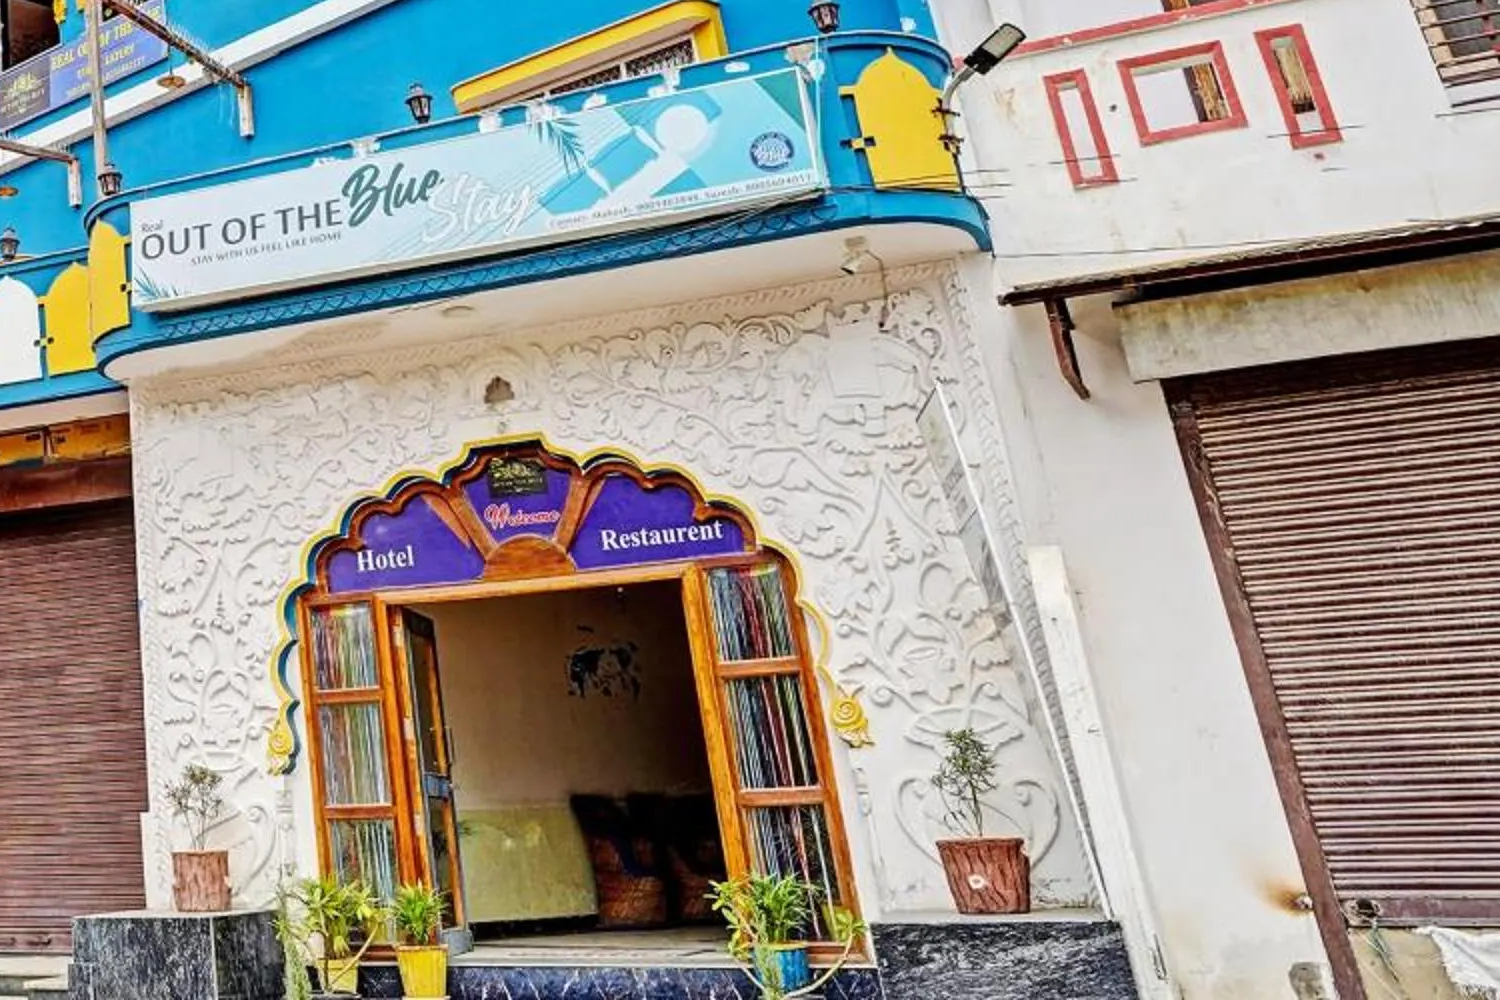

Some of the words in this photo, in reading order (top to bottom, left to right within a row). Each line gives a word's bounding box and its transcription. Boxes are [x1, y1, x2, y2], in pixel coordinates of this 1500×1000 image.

[140, 223, 212, 260] OUT
[221, 213, 266, 245] OF
[274, 199, 343, 235] THE
[341, 161, 443, 227] Blue
[421, 172, 533, 243] Stay
[141, 219, 164, 233] Real
[190, 255, 214, 266] STAY
[215, 249, 243, 263] WITH
[244, 246, 259, 258] US
[261, 242, 283, 255] FEEL
[285, 237, 307, 250] LIKE
[309, 230, 342, 246] HOME
[600, 519, 724, 551] Restaurent
[356, 544, 415, 573] Hotel
